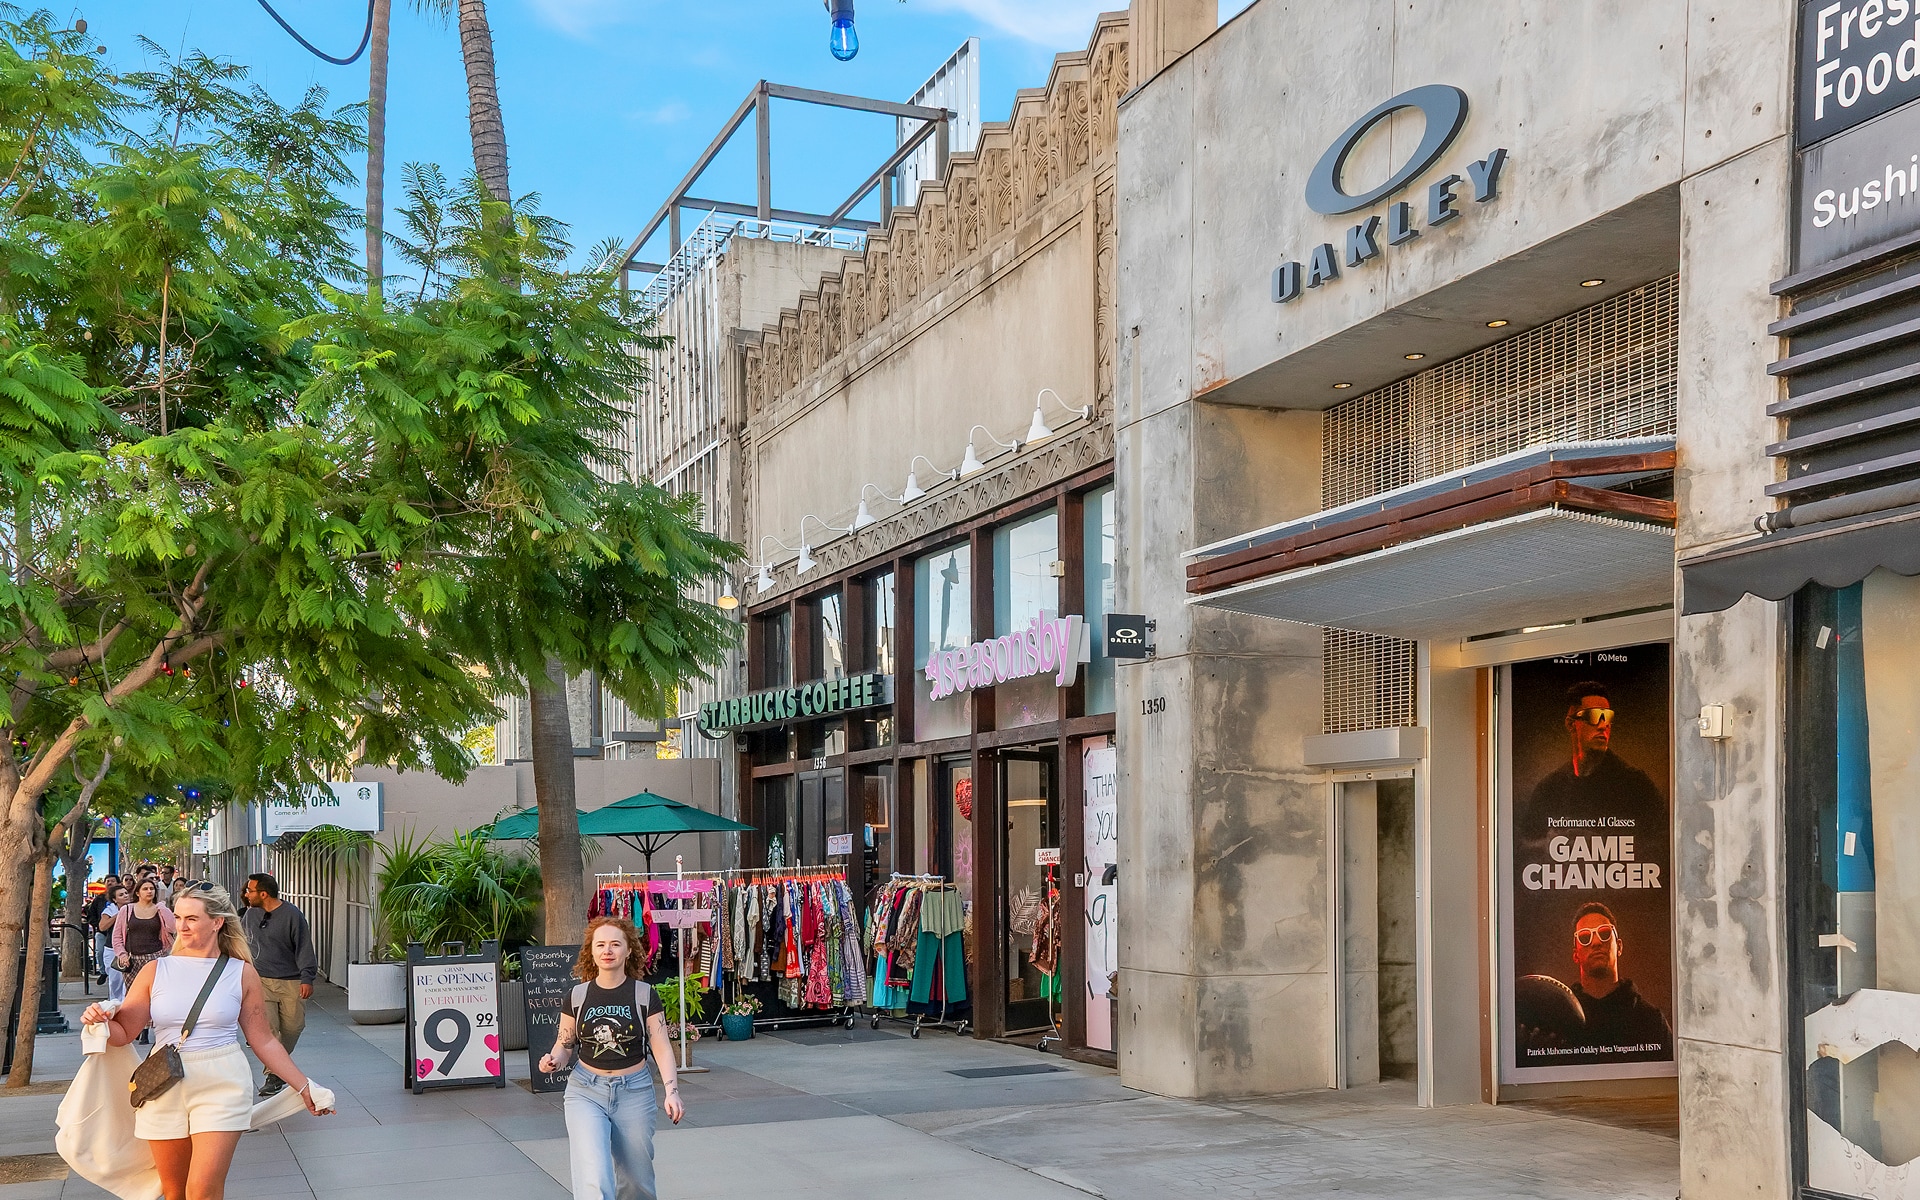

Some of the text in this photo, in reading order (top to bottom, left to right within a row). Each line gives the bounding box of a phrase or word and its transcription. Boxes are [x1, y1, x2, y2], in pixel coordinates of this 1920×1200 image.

[1816, 0, 1920, 62] Fres
[1814, 19, 1920, 121] Food
[1812, 154, 1918, 228] Sushi
[1272, 148, 1507, 303] OAKLEY
[942, 608, 1073, 697] seasonsby
[1607, 653, 1628, 662] Meta
[700, 674, 875, 731] STARBUCKS COFFEE
[1141, 696, 1166, 716] 1350
[813, 756, 827, 770] 1356
[311, 796, 340, 807] OPEN
[1096, 811, 1118, 845] YOU
[1547, 816, 1636, 828] Performance AI Glasses
[1549, 835, 1635, 863] GAME
[1522, 863, 1662, 890] CHANGER
[667, 880, 695, 894] SALE
[525, 949, 574, 963] Seasonsby
[416, 971, 494, 986] RE OPENING
[424, 994, 488, 1006] EVERYTHING
[527, 986, 563, 996] will have
[584, 1005, 632, 1021] BOWIE
[419, 1008, 493, 1077] $ 9 99
[1527, 1043, 1662, 1057] Patrick Mahomes in Oakley Meta Vanguard & HSTN
